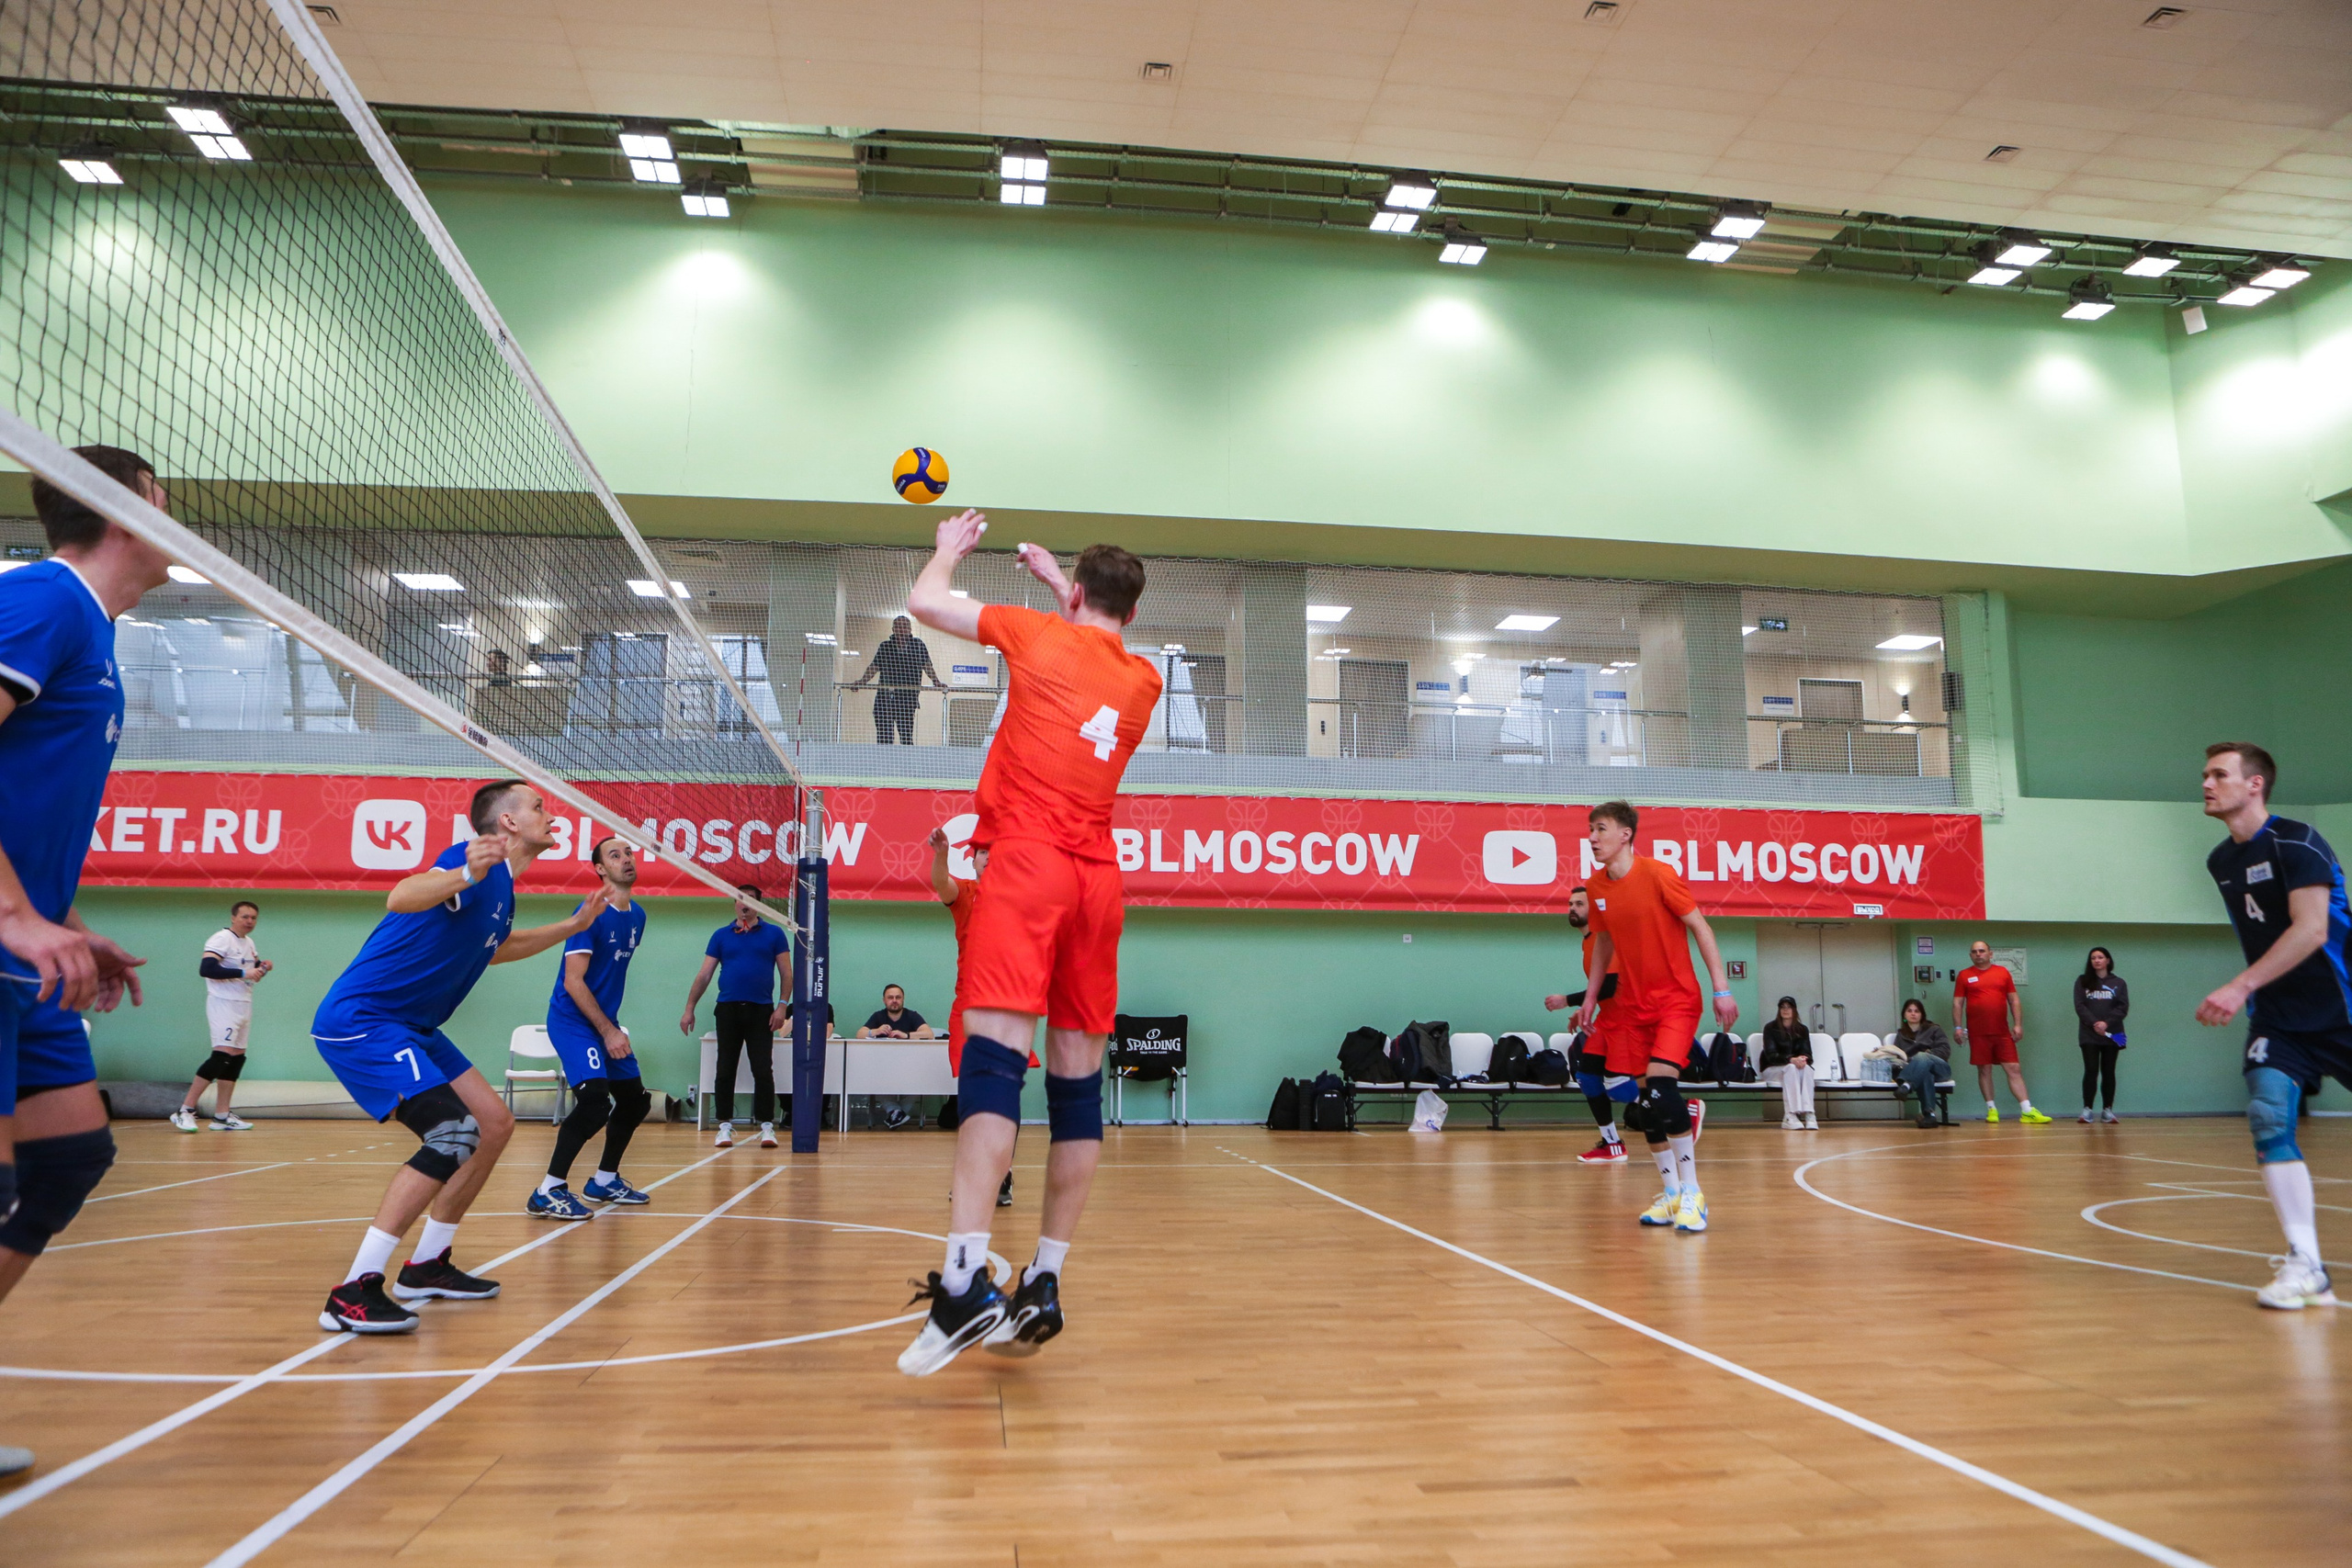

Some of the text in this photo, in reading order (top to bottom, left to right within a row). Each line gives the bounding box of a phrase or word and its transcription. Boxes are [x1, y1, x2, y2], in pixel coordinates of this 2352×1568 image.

[1079, 704, 1120, 762] 4
[366, 820, 413, 851] VK
[1112, 828, 1420, 876] BLMOSCOW
[1579, 838, 1925, 885] MBLMOSCOW
[2244, 893, 2266, 922] 4
[224, 1027, 233, 1042] 2
[1126, 1037, 1182, 1052] SPALDING
[2247, 1036, 2269, 1063] 4
[393, 1047, 421, 1082] 7
[586, 1046, 601, 1069] 8
